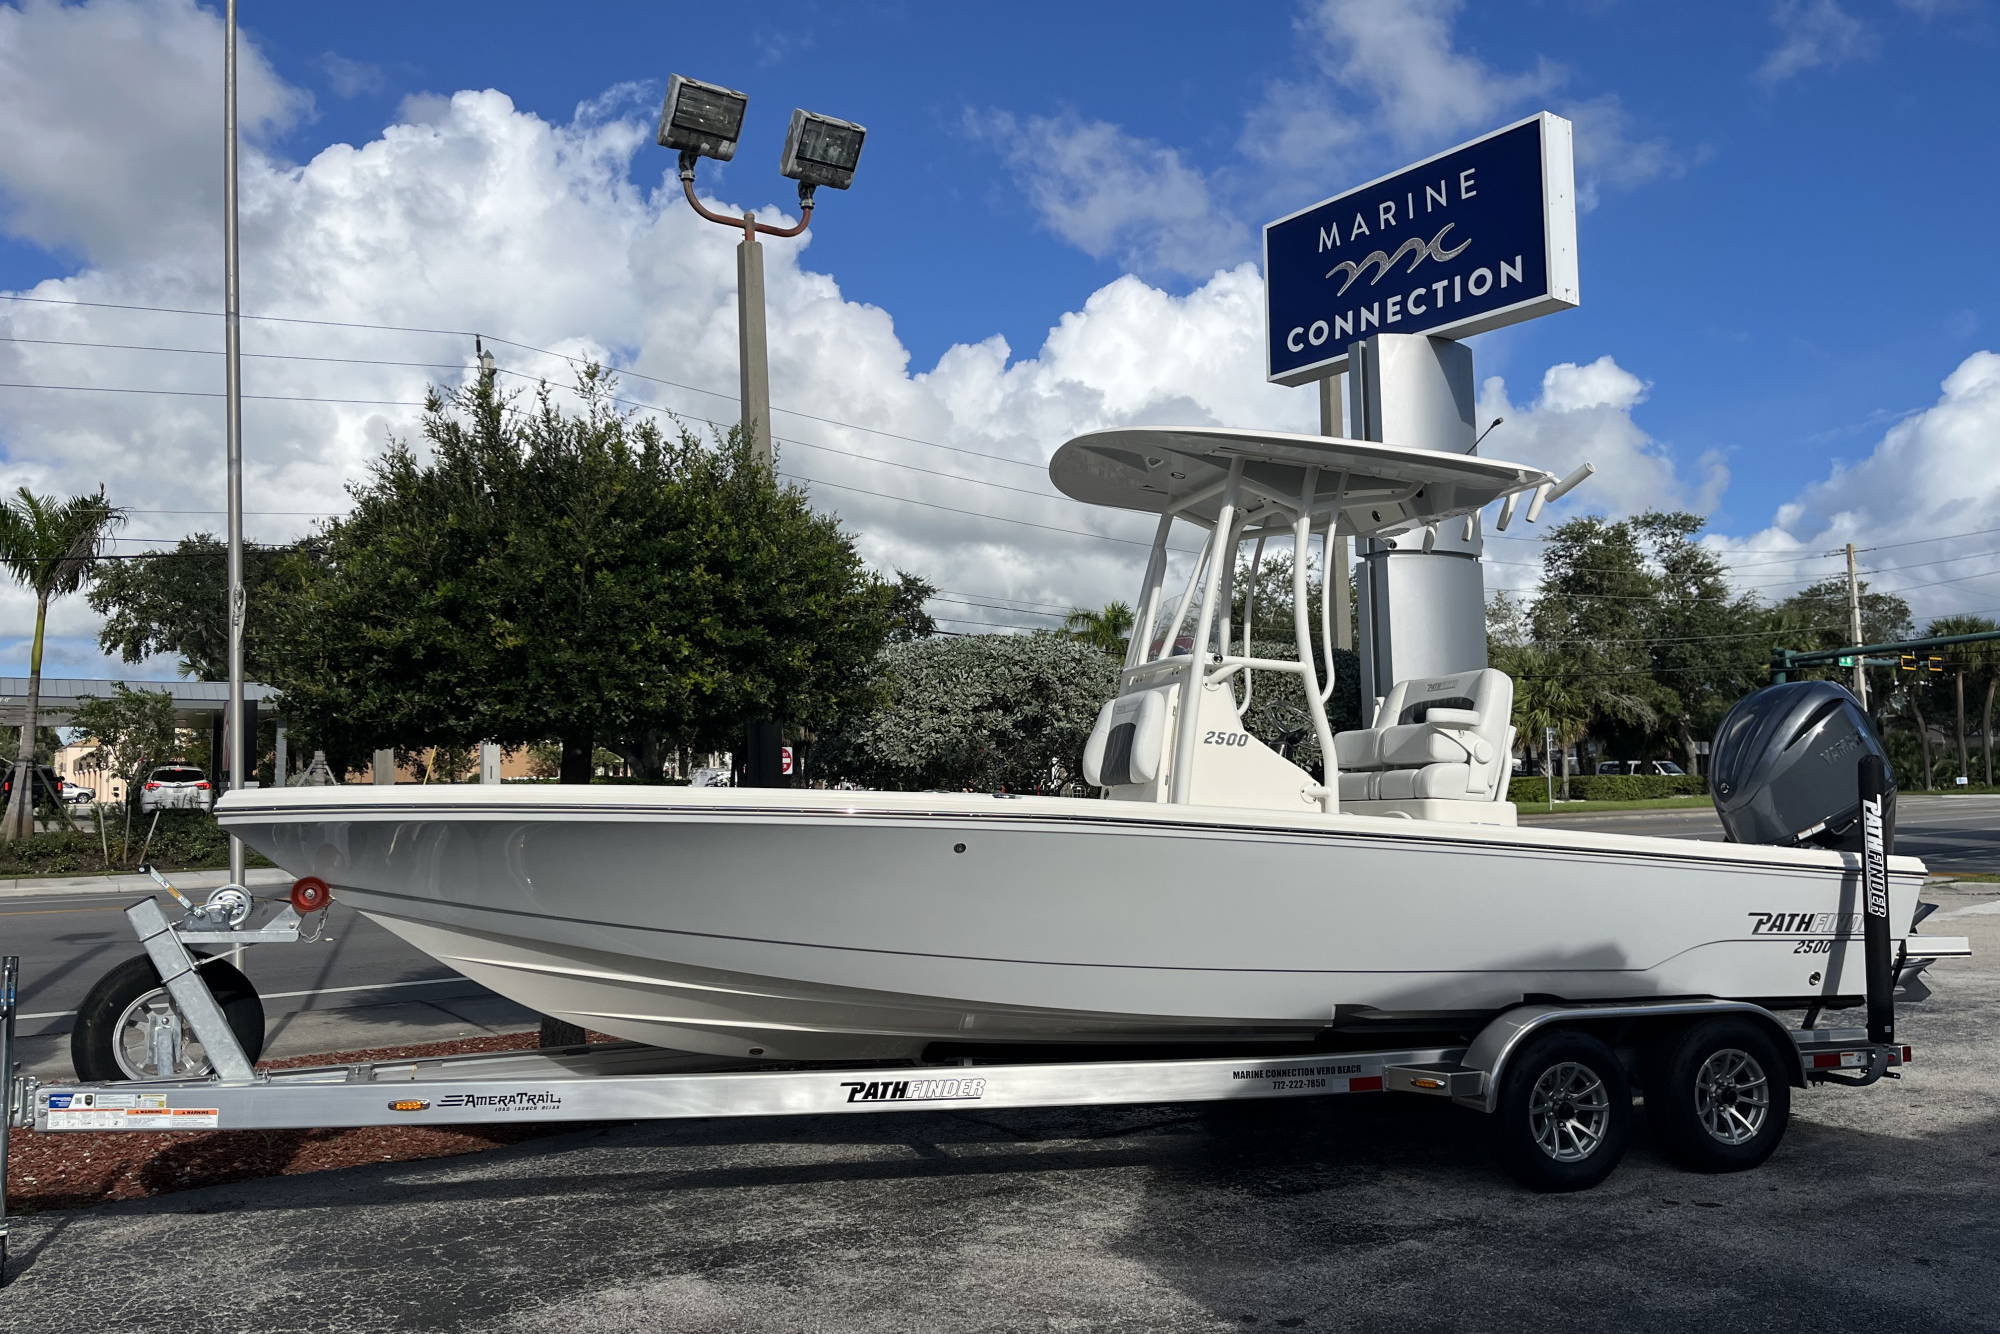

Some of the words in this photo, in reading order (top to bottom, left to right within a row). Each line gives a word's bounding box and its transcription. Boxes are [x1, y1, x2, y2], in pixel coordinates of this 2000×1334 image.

[1318, 168, 1477, 252] MARINE
[1287, 255, 1523, 352] CONNECTION
[1204, 731, 1249, 747] 2500
[1863, 794, 1886, 918] PATHFINDER
[1793, 940, 1831, 954] 2500
[1232, 1070, 1264, 1080] MARINE
[1265, 1067, 1315, 1078] CONNECTION
[1316, 1065, 1336, 1076] VERO
[1337, 1064, 1362, 1075] BEACH
[840, 1078, 986, 1103] PATHFINDER
